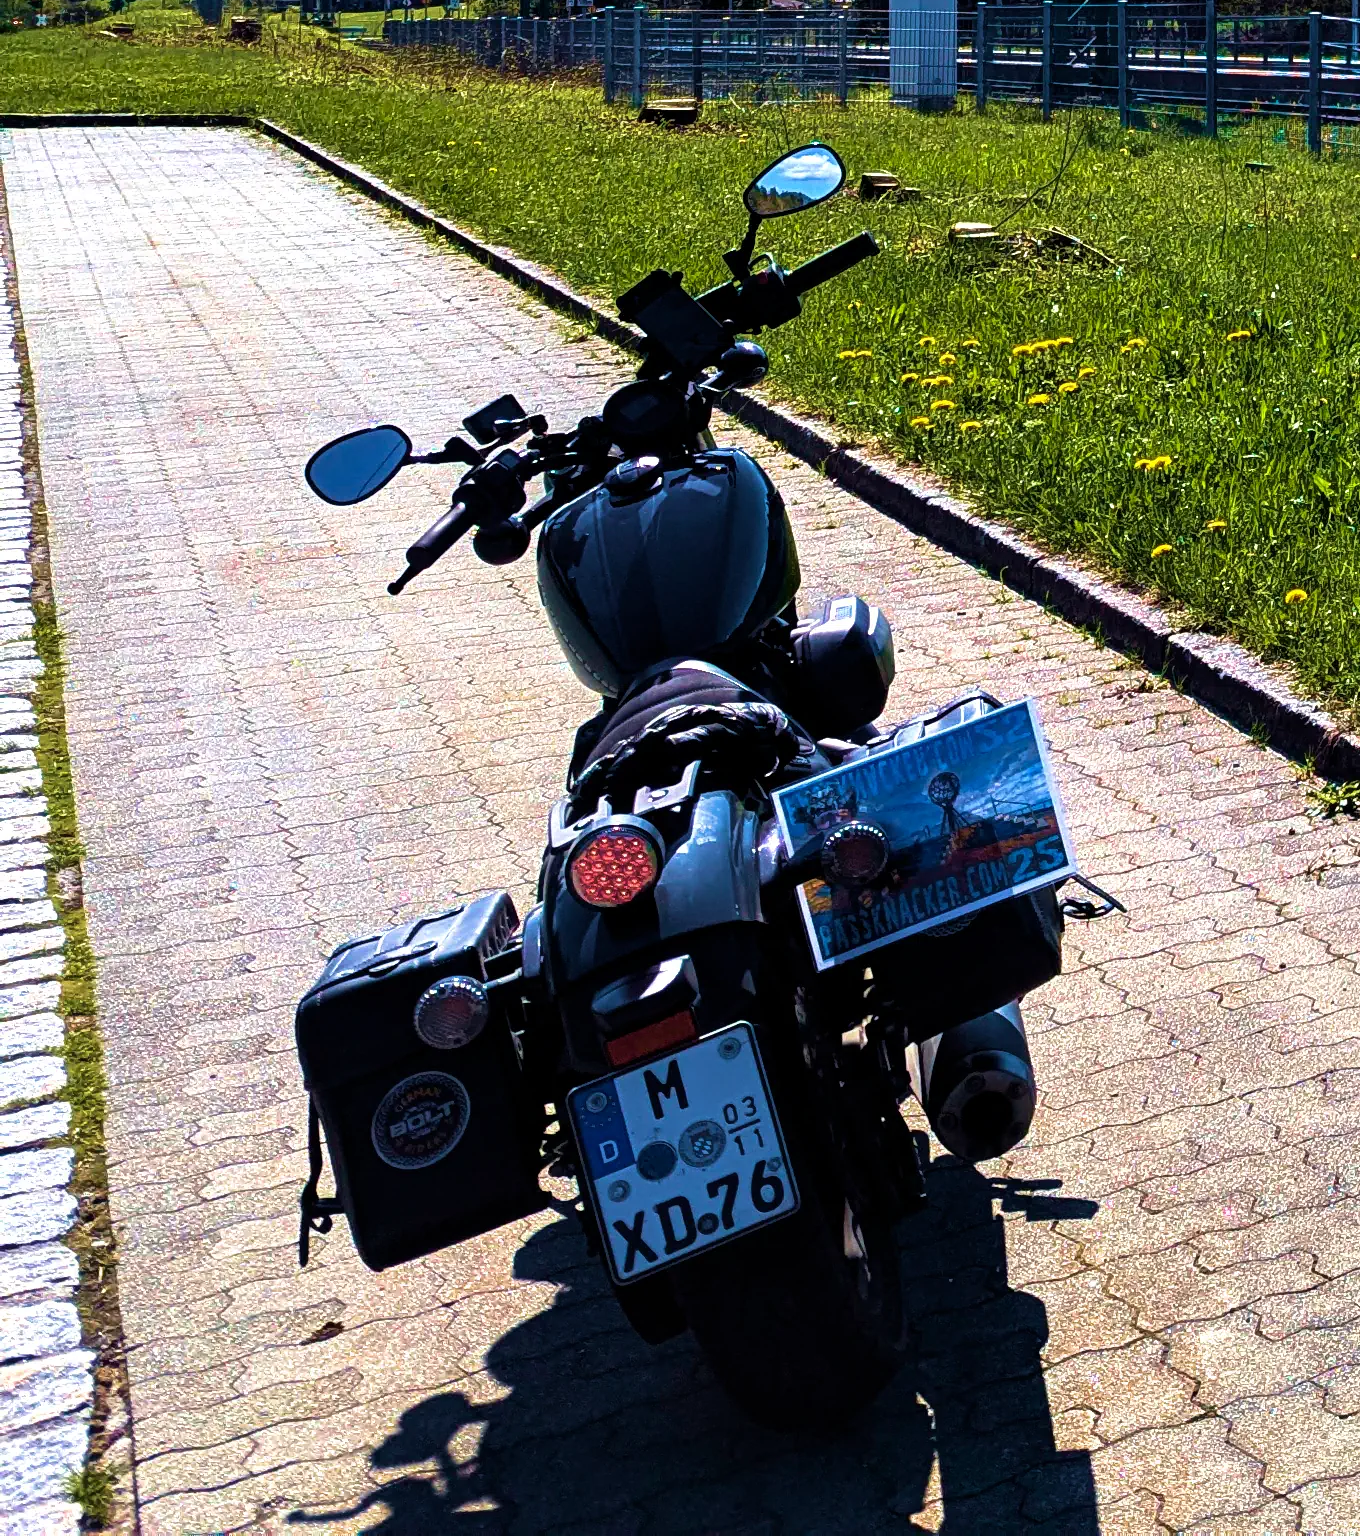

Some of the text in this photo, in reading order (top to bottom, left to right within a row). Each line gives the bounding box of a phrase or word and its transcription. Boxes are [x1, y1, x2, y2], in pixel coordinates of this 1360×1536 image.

[818, 834, 1065, 957] PASSKNACKER.COM 25
[643, 1059, 689, 1120] M
[389, 1100, 456, 1138] BOLT
[722, 1096, 758, 1125] 03
[599, 1140, 619, 1164] D
[733, 1128, 764, 1156] 11
[706, 1159, 785, 1230] 76
